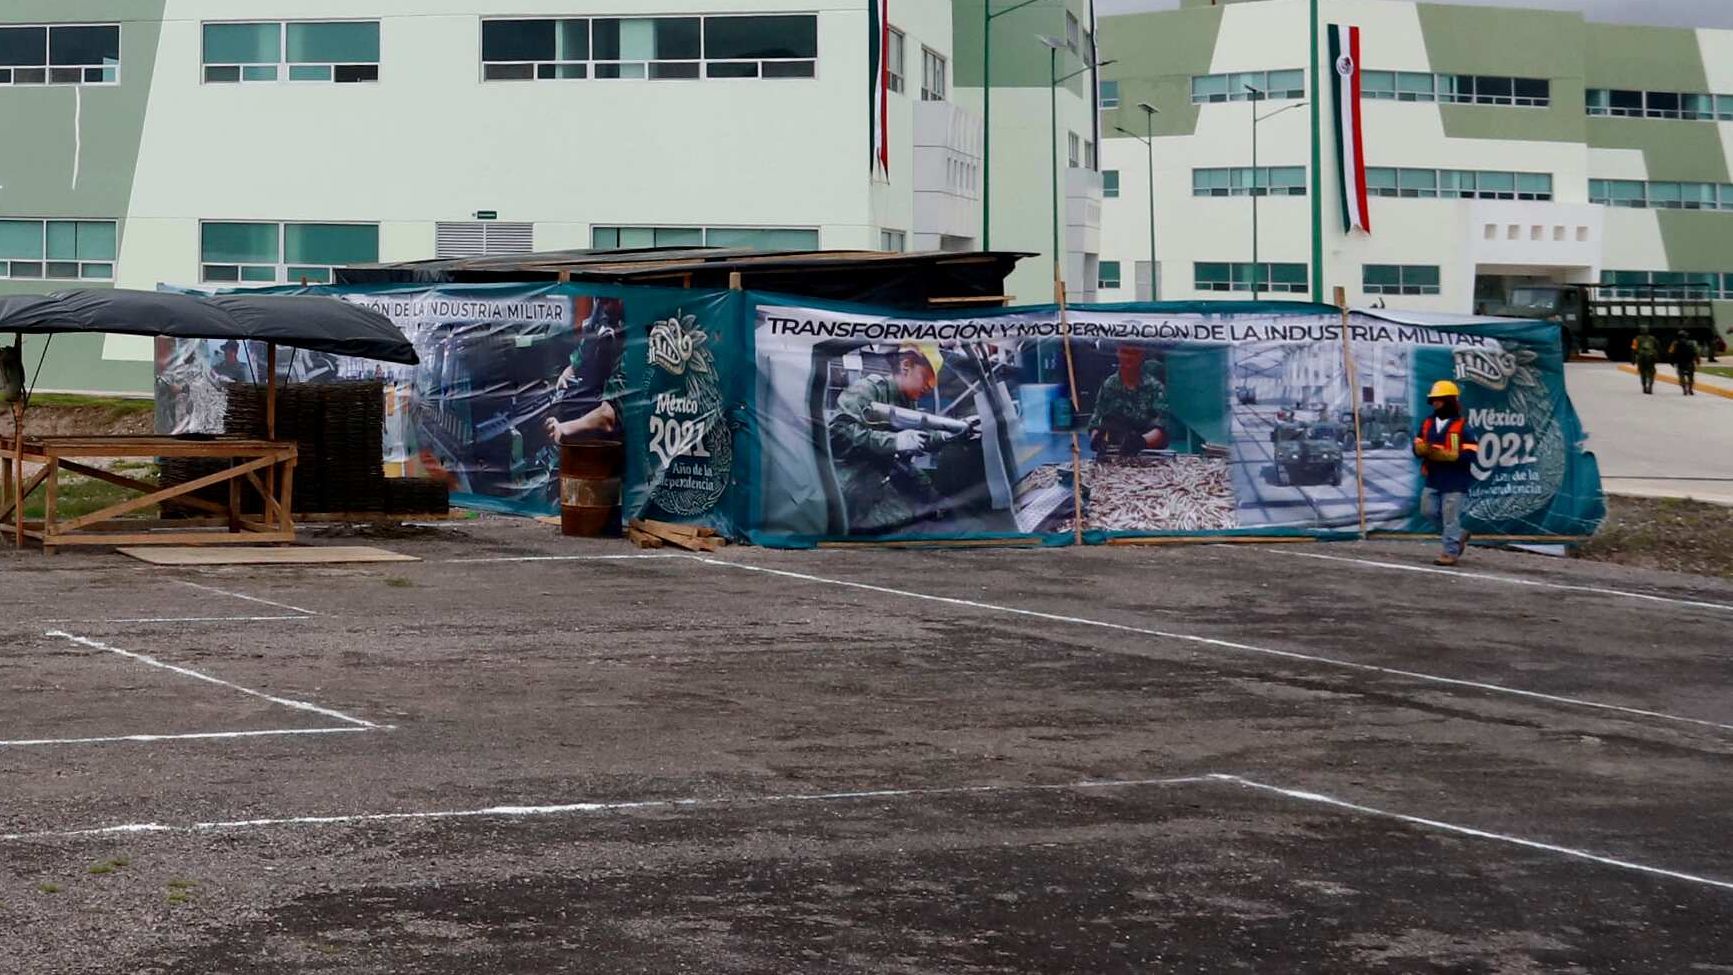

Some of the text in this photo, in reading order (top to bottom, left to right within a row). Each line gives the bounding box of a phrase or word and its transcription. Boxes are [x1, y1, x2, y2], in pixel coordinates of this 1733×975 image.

[395, 303, 409, 316] DE
[429, 301, 501, 319] NDUSTRIA
[507, 303, 563, 321] MILITAR
[767, 317, 1484, 346] TRANSFORMACIÓN Y MODERNIZACIÓN DE LA INDUSTRIA MILITAR
[654, 392, 698, 417] México
[1468, 408, 1525, 430] México
[649, 415, 710, 468] 2021
[1470, 432, 1538, 481] 021
[692, 463, 703, 476] de
[704, 465, 713, 477] la
[1512, 470, 1527, 482] de
[1528, 468, 1540, 481] la
